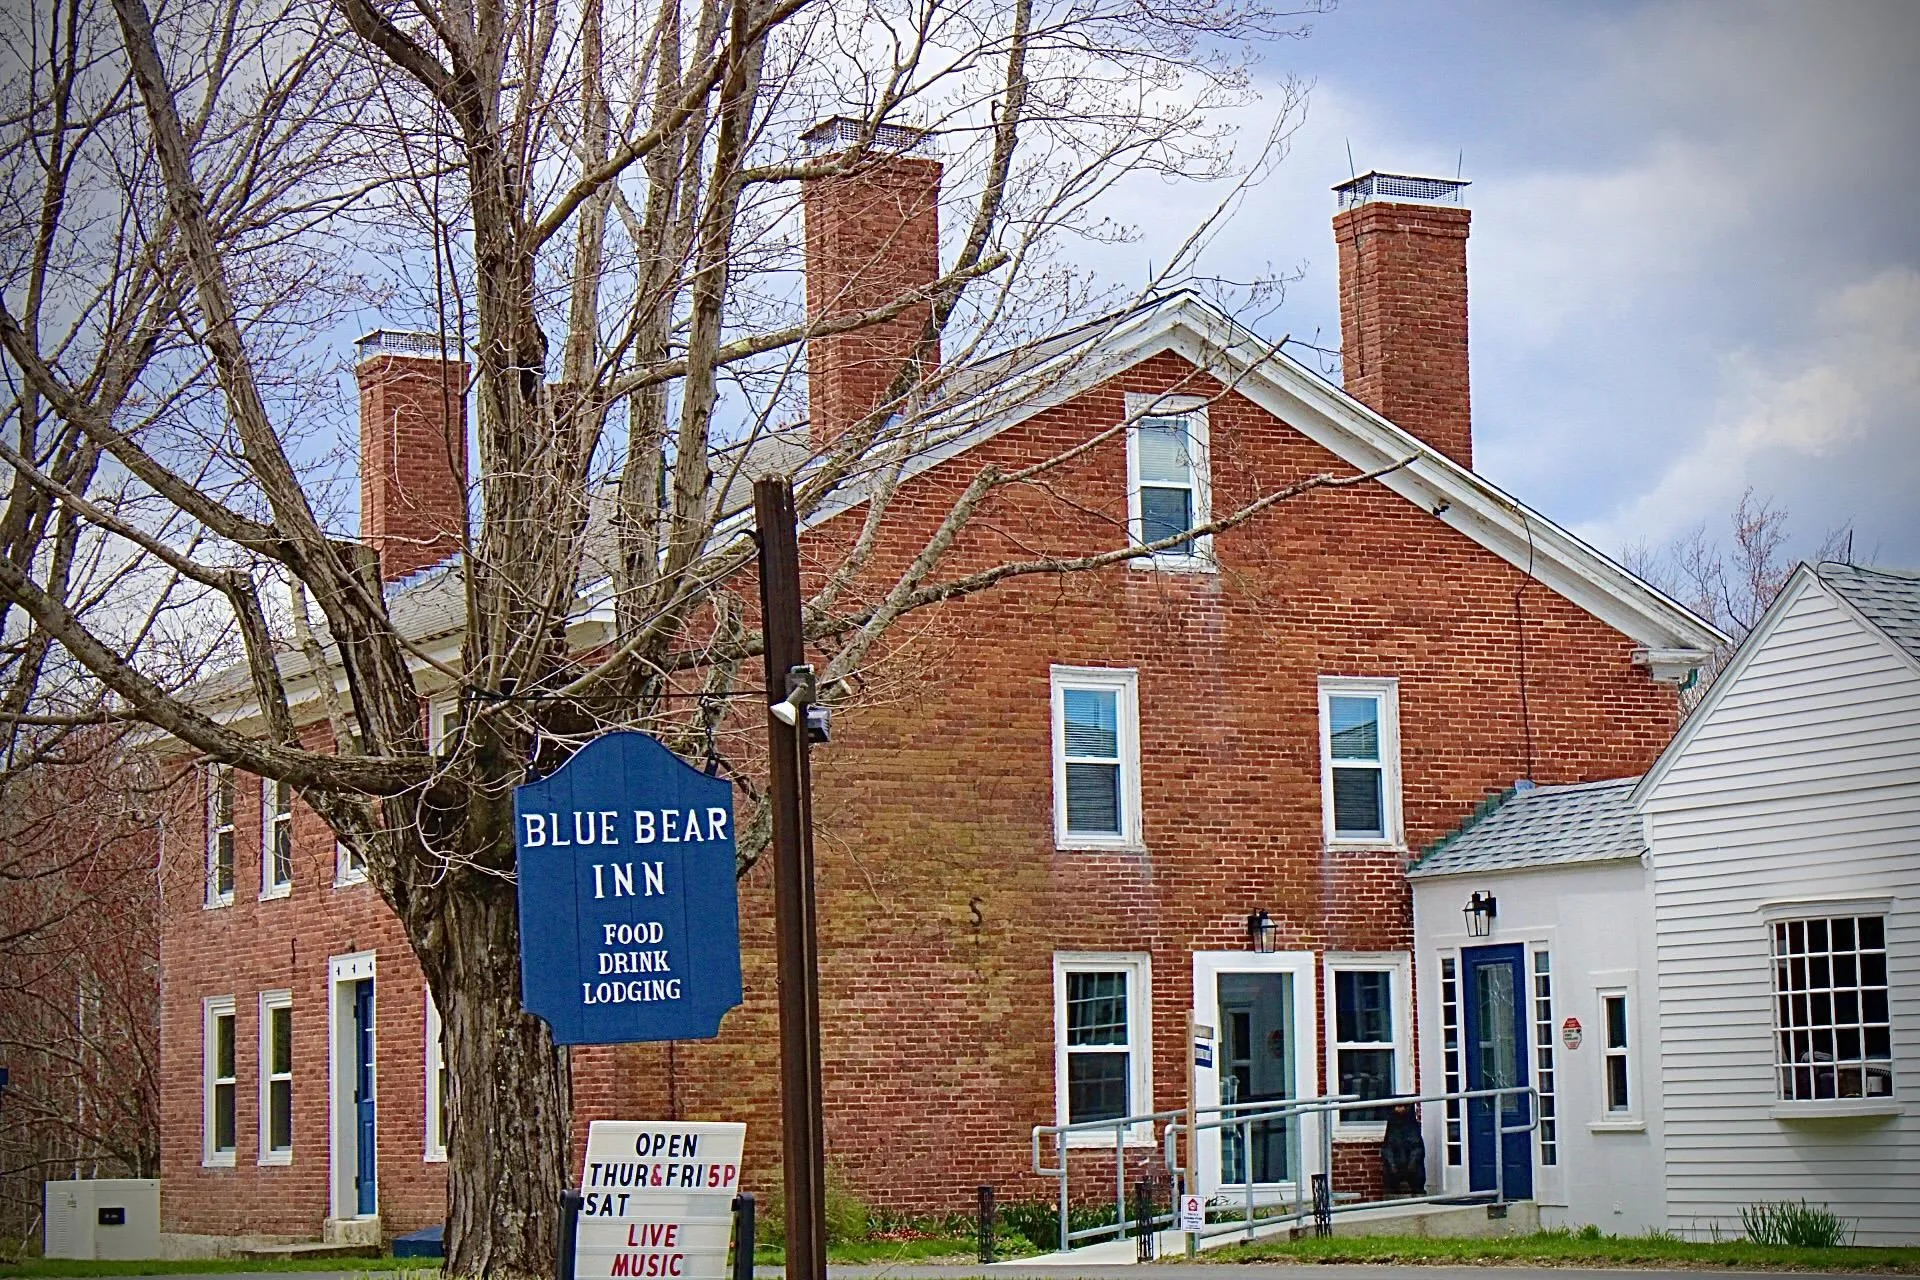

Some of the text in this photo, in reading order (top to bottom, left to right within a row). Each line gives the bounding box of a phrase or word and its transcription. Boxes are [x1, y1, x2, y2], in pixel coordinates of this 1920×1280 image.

[522, 808, 728, 847] BLUE BEAR
[592, 862, 664, 898] INN
[603, 922, 663, 945] FOOD
[598, 951, 670, 974] DRINK
[583, 979, 681, 1004] LODGING
[635, 1133, 698, 1158] OPEN
[707, 1164, 736, 1188] 5P
[585, 1193, 631, 1217] SAT
[627, 1223, 678, 1248] LIVE
[611, 1253, 684, 1277] MUSIC
